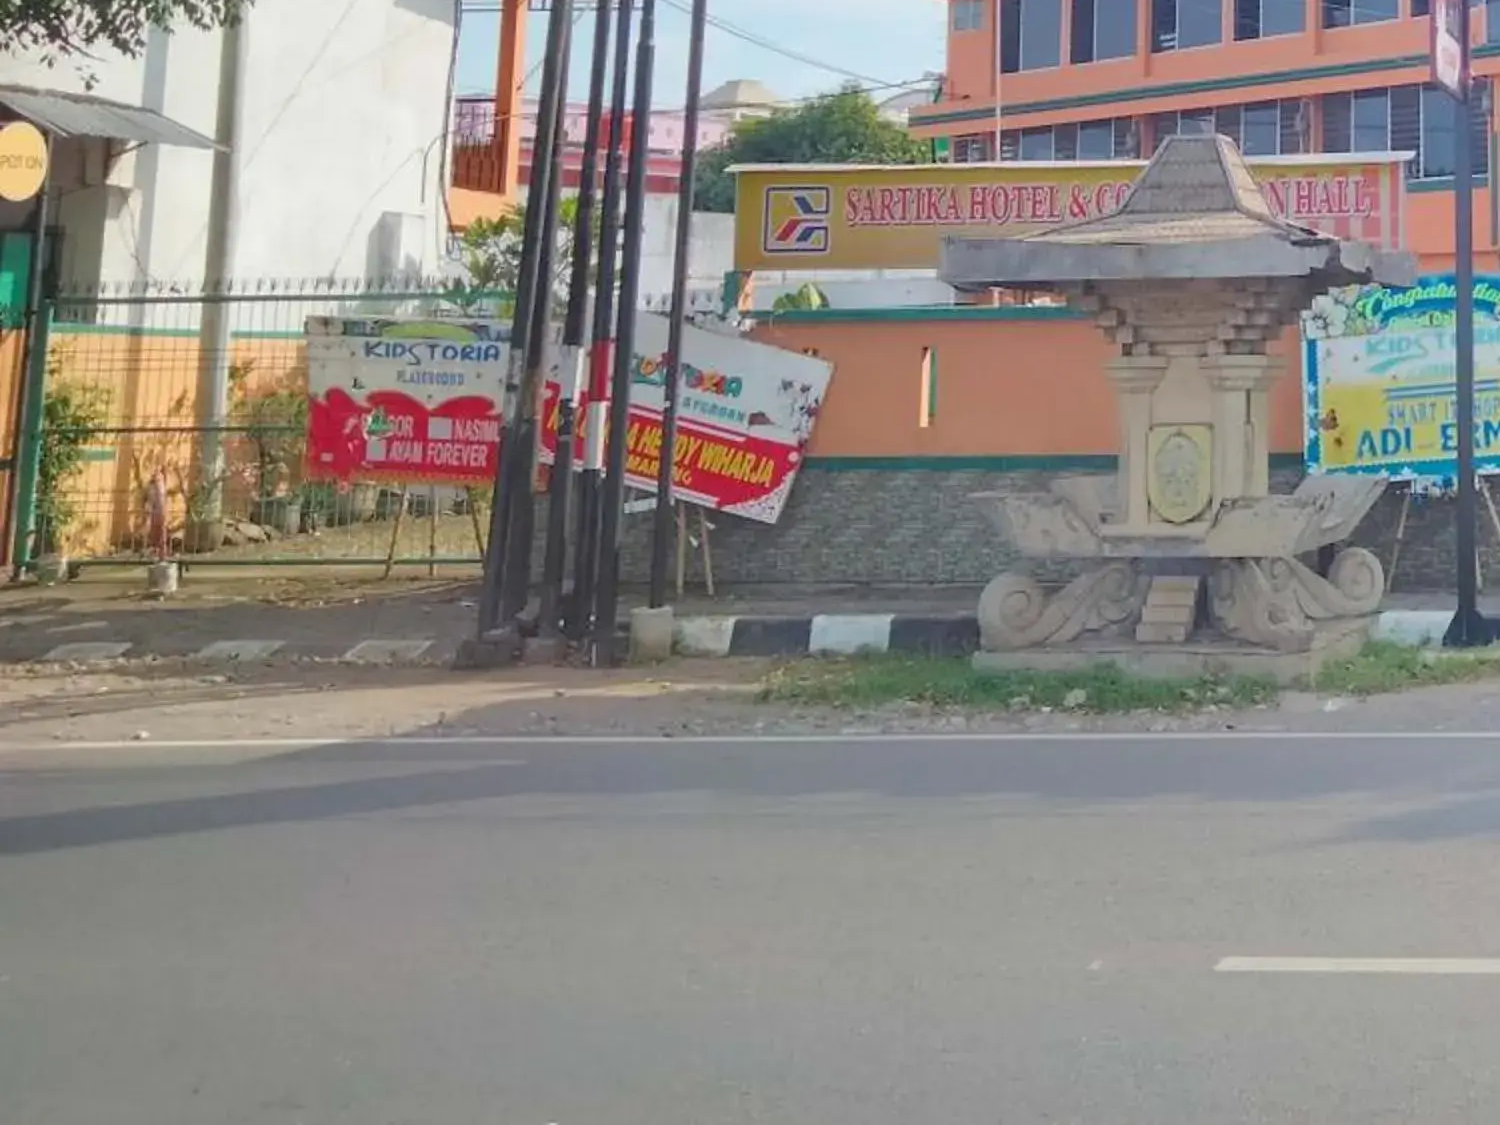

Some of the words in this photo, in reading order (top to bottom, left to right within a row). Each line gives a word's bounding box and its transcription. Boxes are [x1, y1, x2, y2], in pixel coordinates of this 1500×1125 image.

[846, 184, 959, 224] SARTIKA
[969, 185, 1062, 224] HOTEL
[1068, 185, 1091, 219] &
[1294, 178, 1374, 217] HALL
[364, 340, 501, 366] KIDSTORIA
[427, 442, 489, 467] FOREVER
[641, 424, 702, 467] HEDY
[698, 439, 775, 488] WIHARJA
[1357, 426, 1413, 460] ADI
